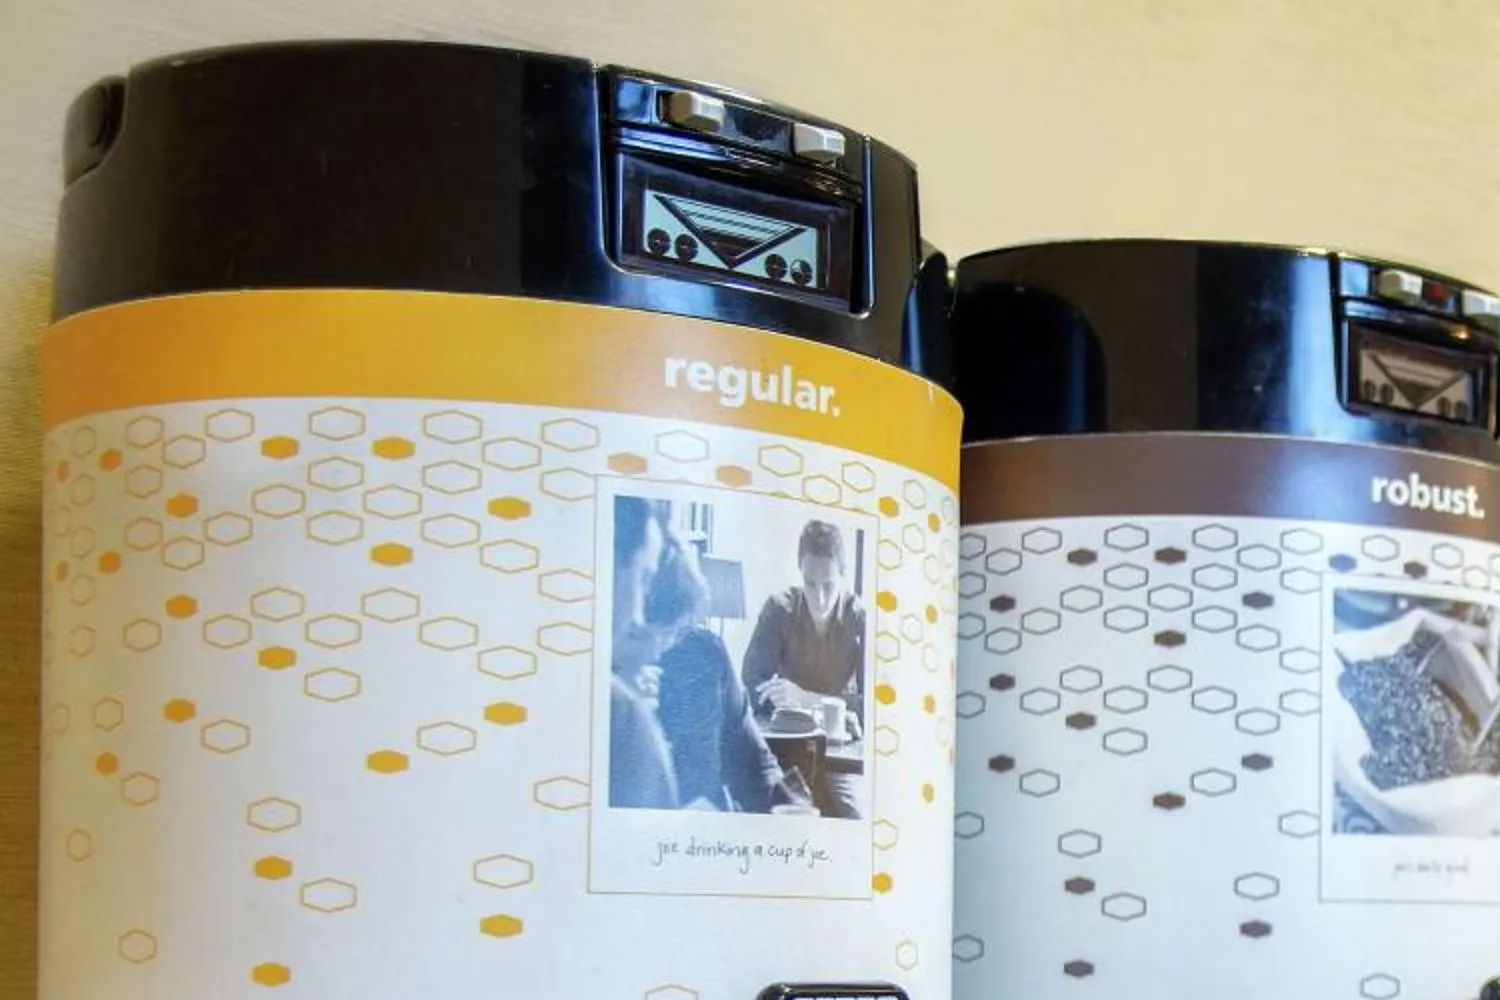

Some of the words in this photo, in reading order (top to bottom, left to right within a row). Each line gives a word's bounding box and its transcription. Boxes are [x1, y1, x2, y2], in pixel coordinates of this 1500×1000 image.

[664, 356, 841, 418] regular.
[1371, 470, 1485, 519] robust.
[653, 839, 679, 867] joe
[684, 835, 750, 875] drinking
[753, 844, 763, 856] a
[767, 844, 793, 863] cup
